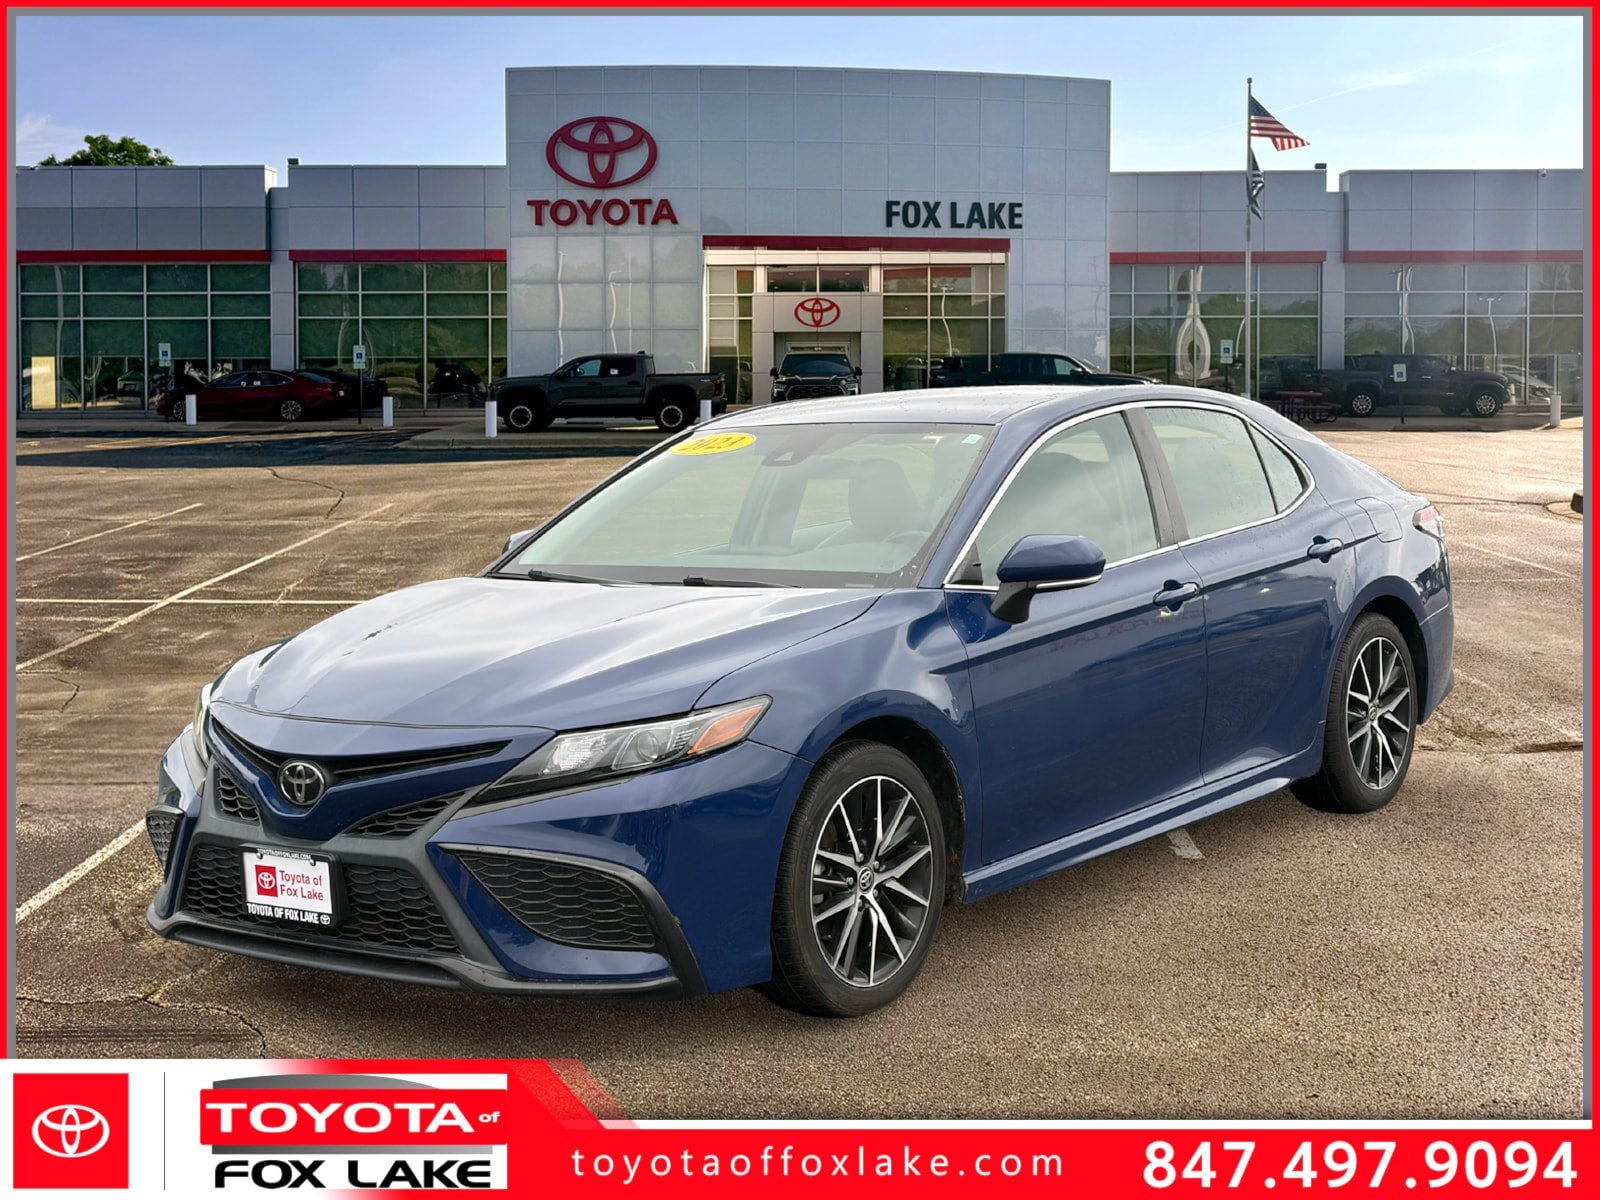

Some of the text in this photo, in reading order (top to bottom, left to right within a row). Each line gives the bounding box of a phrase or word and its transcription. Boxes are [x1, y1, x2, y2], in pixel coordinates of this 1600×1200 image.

[527, 198, 679, 227] TOYOTA
[884, 200, 1024, 230] FOX LAKE
[678, 436, 747, 451] 2023
[279, 870, 323, 886] Toyota of
[280, 884, 324, 901] Fox Lake
[246, 903, 320, 924] TOYOTA OF FOX LAKE
